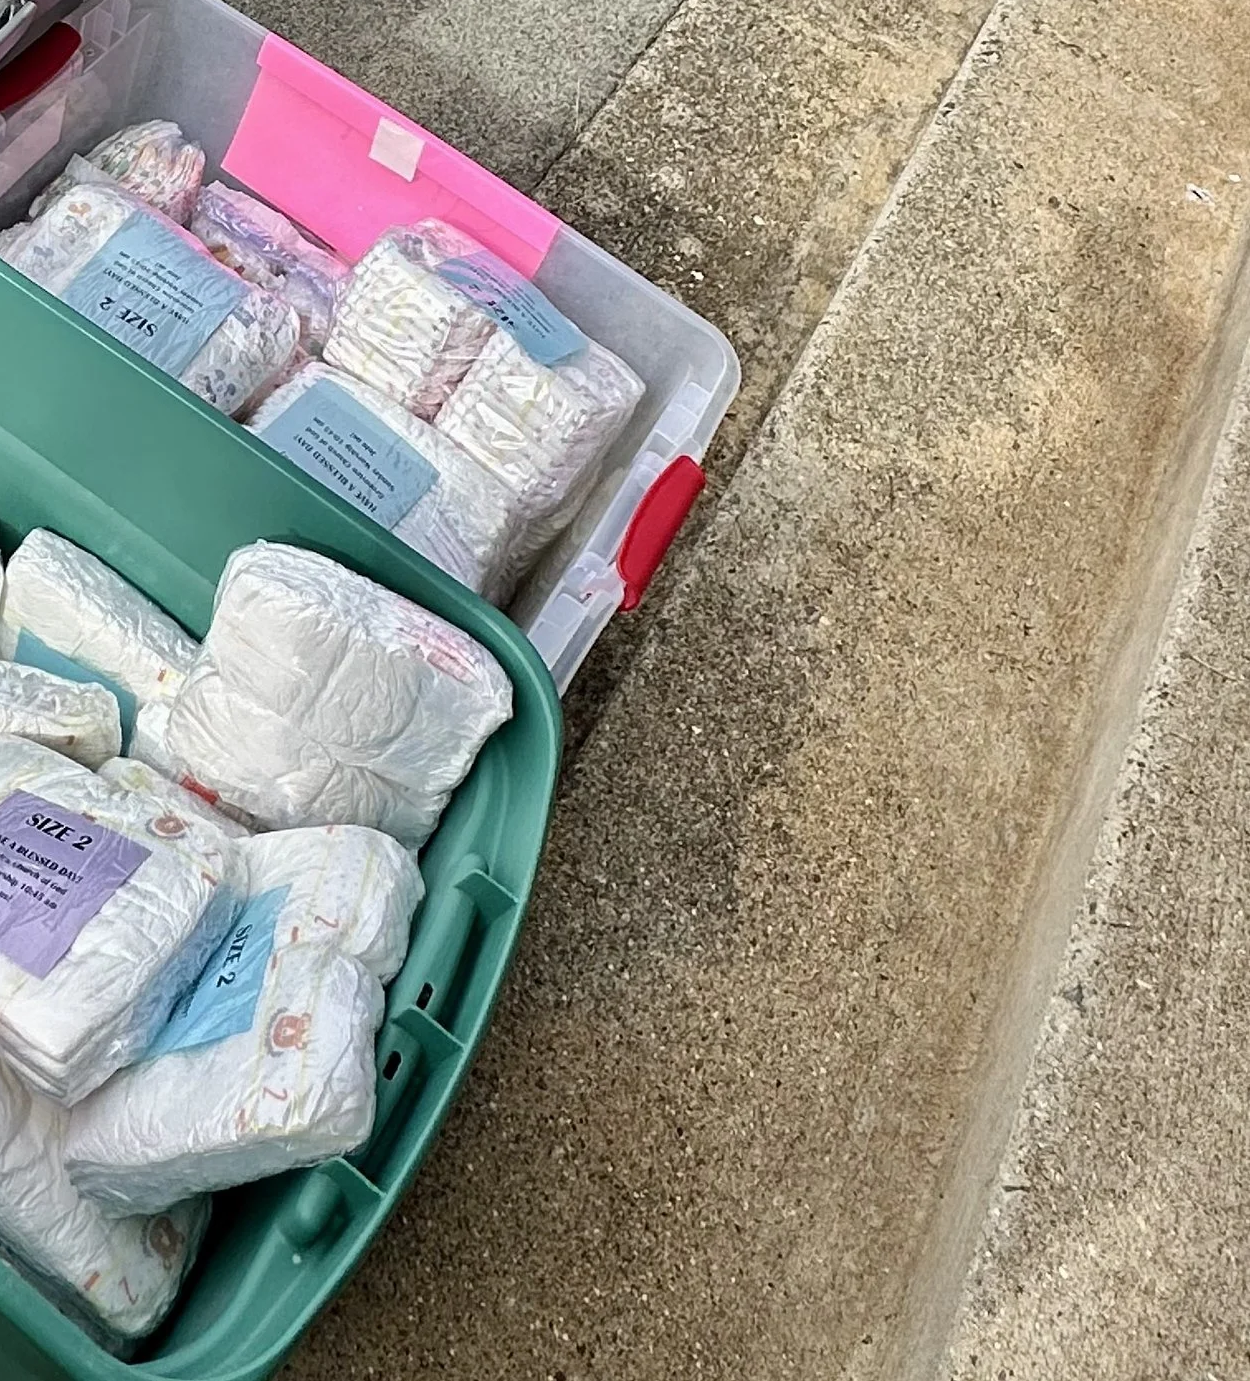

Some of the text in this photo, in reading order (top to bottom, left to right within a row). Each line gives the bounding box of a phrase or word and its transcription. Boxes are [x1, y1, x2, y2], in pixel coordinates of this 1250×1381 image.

[116, 308, 157, 336] SIZE
[313, 451, 348, 485] BLESSED
[354, 491, 376, 512] HAVE
[26, 813, 92, 851] SIZE 2
[9, 842, 16, 850] A
[16, 846, 58, 870] BLESSED
[12, 862, 40, 879] Church
[50, 882, 68, 895] God
[20, 883, 44, 901] 10:45
[224, 923, 254, 965] SIZE
